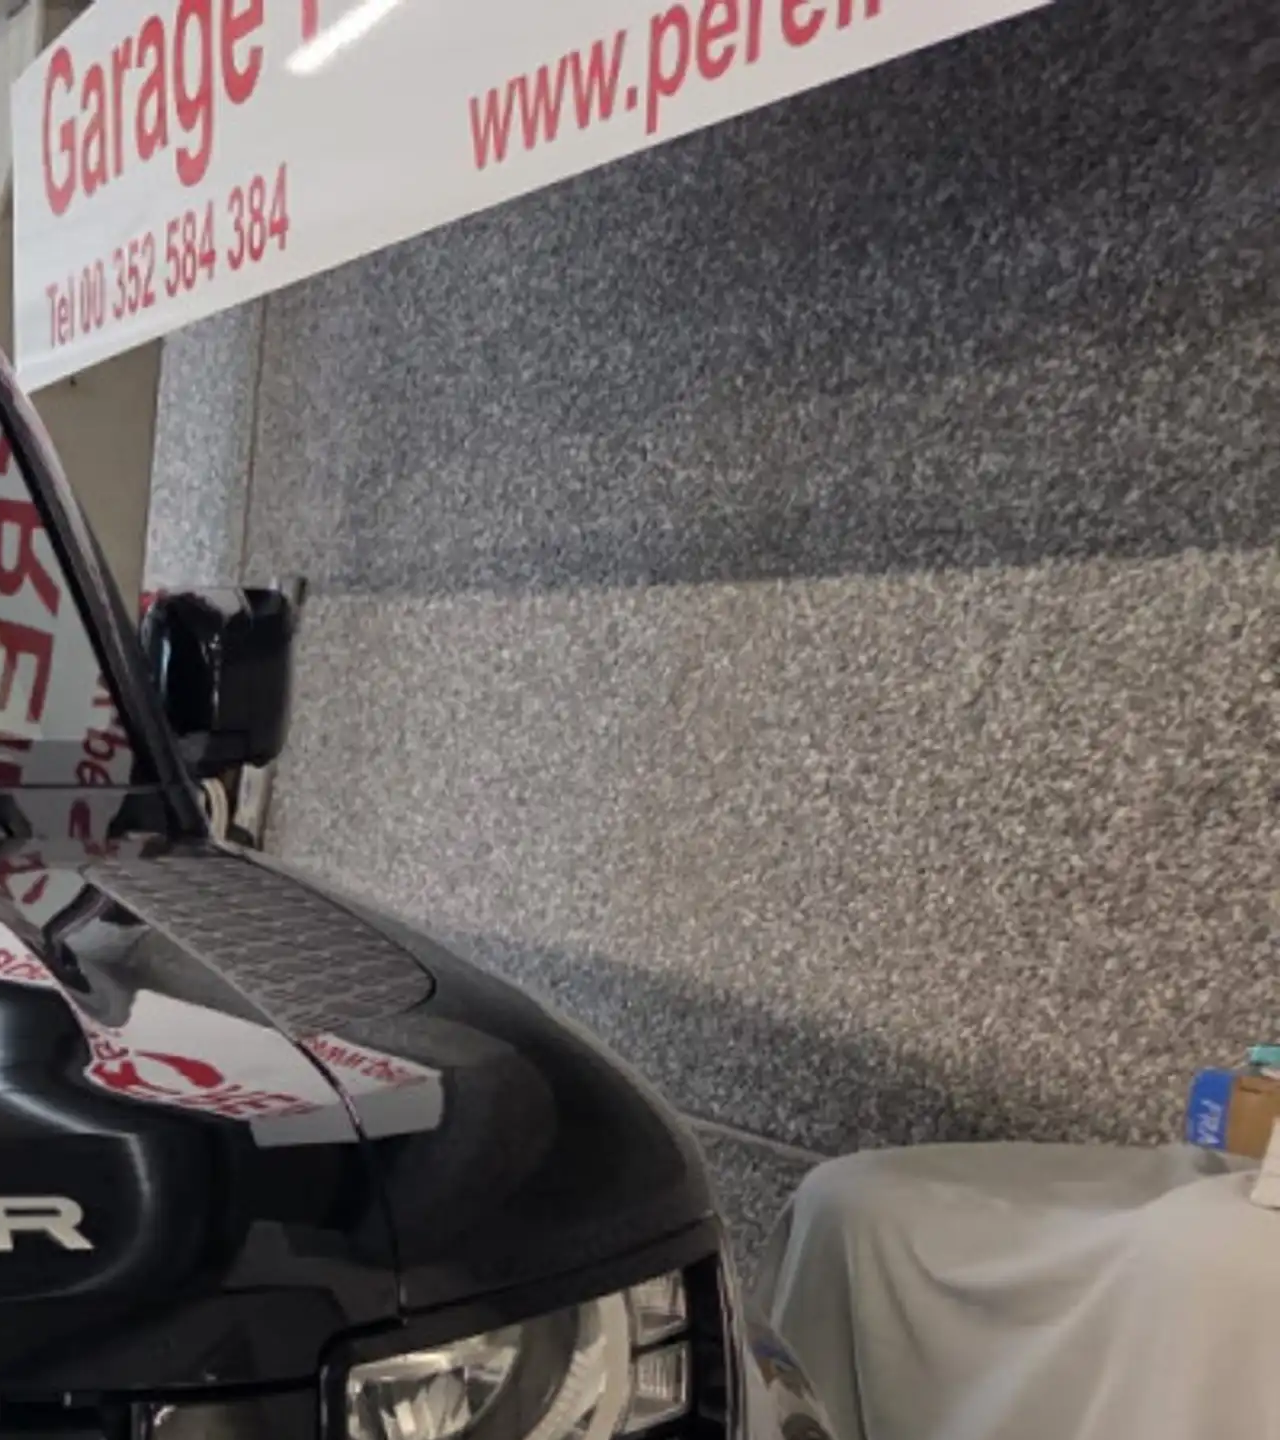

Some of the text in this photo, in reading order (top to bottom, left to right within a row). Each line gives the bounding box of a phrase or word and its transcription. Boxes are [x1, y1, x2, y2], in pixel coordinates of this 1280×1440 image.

[43, 0, 264, 217] Garage
[46, 161, 290, 349] Tel 00 352 584 384
